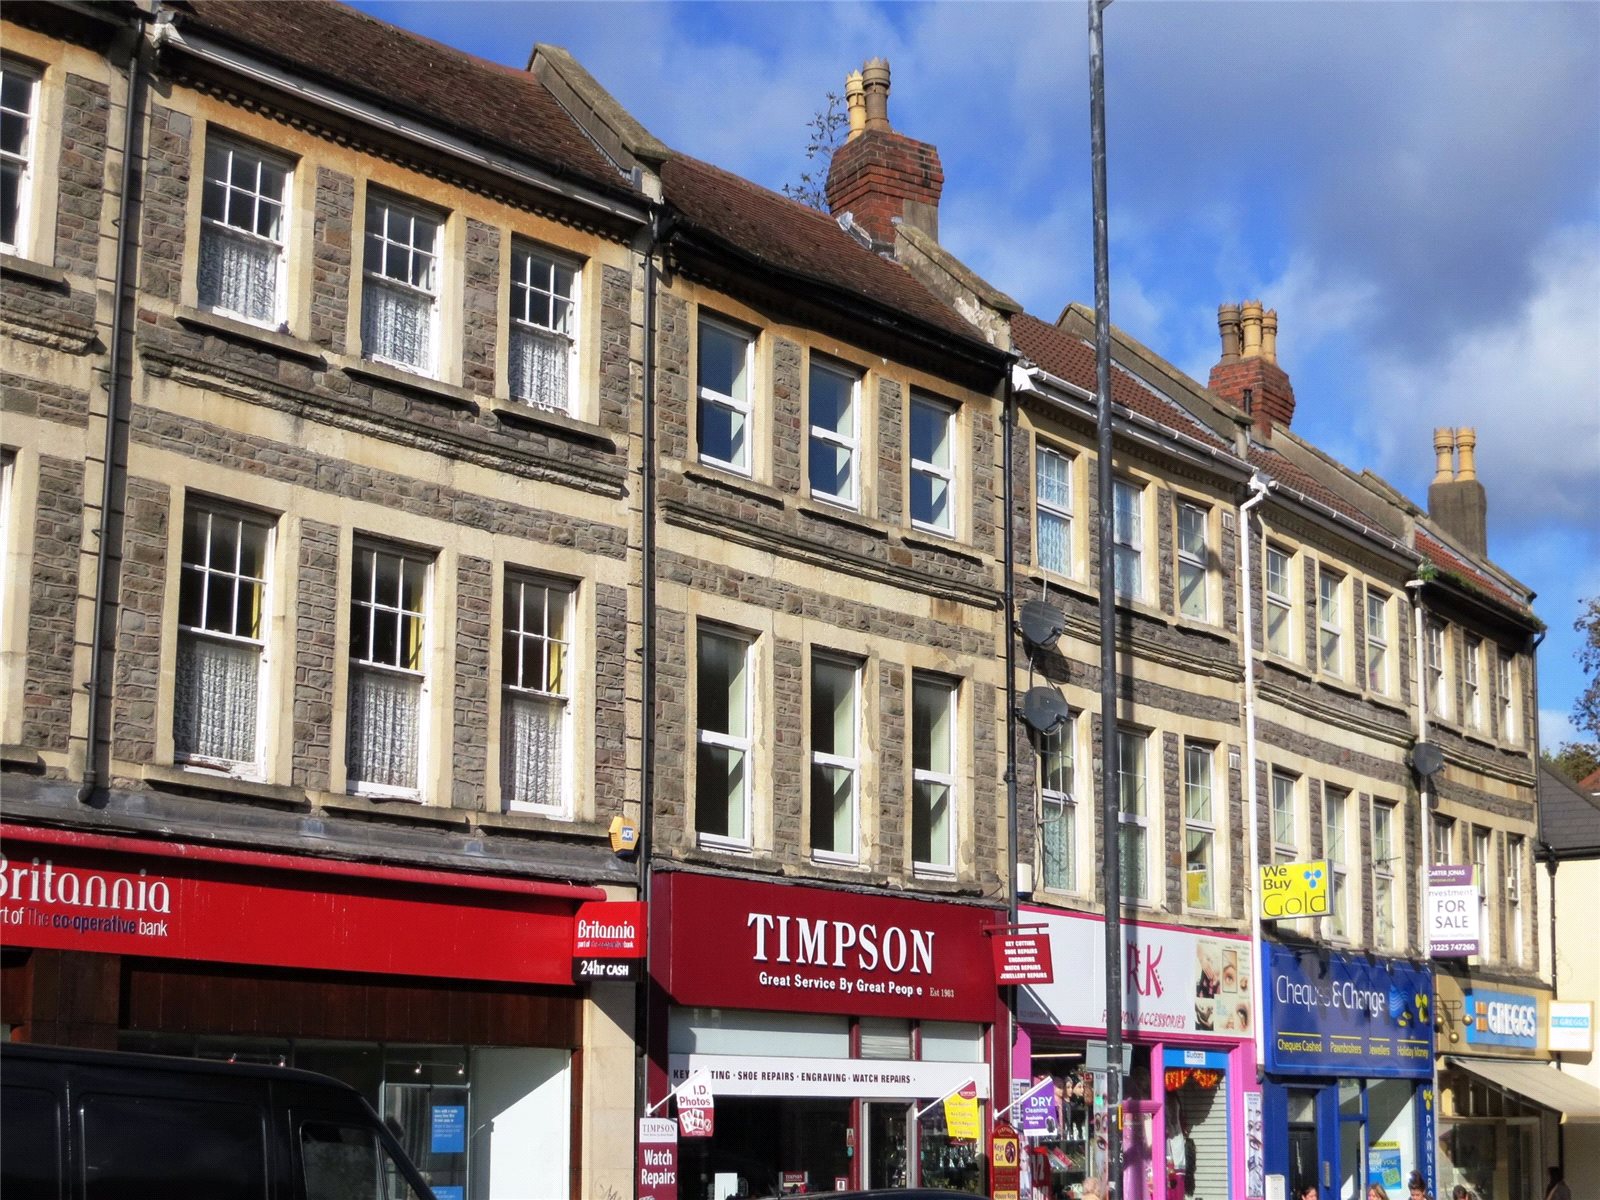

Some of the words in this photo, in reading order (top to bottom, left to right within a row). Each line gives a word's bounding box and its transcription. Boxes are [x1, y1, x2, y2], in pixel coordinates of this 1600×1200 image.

[1263, 865, 1287, 878] We
[1447, 869, 1465, 877] JONAS
[1263, 879, 1292, 891] Buy
[1428, 889, 1473, 897] nvestment
[1263, 889, 1326, 917] Gold
[1437, 900, 1466, 913] FOR
[11, 907, 24, 924] of
[139, 918, 168, 937] bank
[577, 919, 635, 939] Britannia
[1435, 915, 1469, 929] SALE
[747, 912, 935, 975] TIMPSON
[581, 960, 605, 976] 24hr
[606, 964, 629, 976] CASH
[759, 971, 791, 987] Great
[794, 974, 836, 990] Service
[840, 977, 853, 994] By
[856, 979, 885, 994] Great
[1276, 975, 1331, 1012] Chequs
[1342, 982, 1385, 1018] Change
[1138, 1012, 1186, 1029] ACCESSORIES
[1487, 1001, 1536, 1038] GREGGS
[1277, 1038, 1302, 1054] Cheques
[1302, 1040, 1322, 1053] Cashed
[1330, 1042, 1362, 1055] Pawnbrokers
[673, 1069, 690, 1079] KEY
[737, 1070, 758, 1081] SHOE
[761, 1071, 795, 1082] REPAIRS
[801, 1072, 847, 1083] ENGRAVING
[852, 1074, 879, 1084] WATCH
[881, 1074, 911, 1084] REPAIRS
[679, 1096, 711, 1106] Photos
[1031, 1096, 1053, 1107] DRY
[642, 1124, 675, 1133] TIMPSON
[644, 1149, 673, 1166] Watch
[641, 1168, 676, 1189] Repairs
